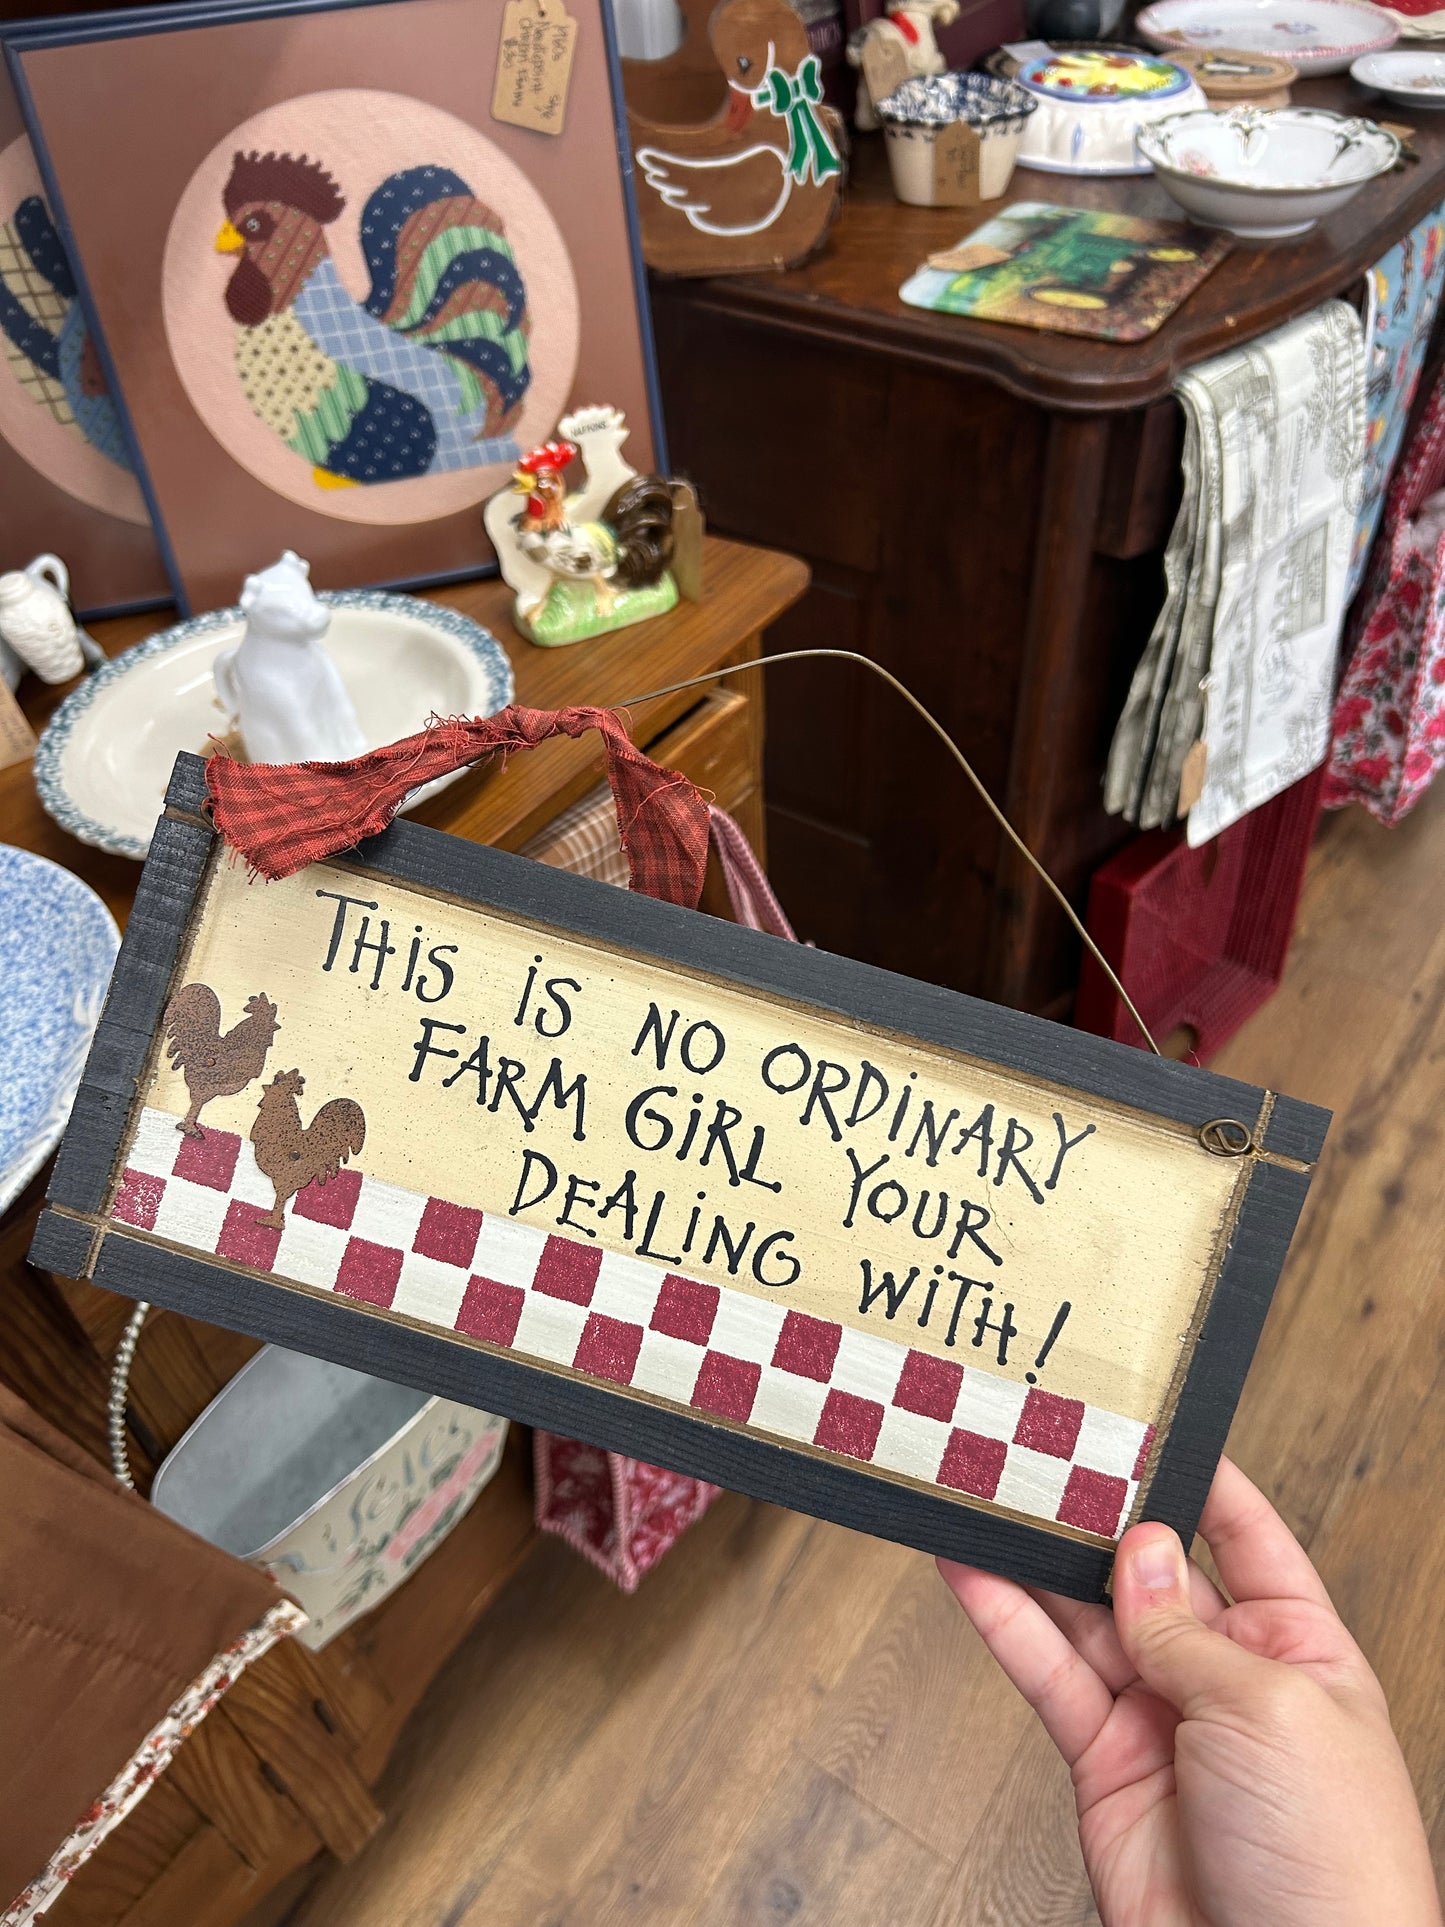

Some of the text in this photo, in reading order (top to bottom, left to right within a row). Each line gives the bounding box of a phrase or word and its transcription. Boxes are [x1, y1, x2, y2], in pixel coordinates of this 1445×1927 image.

[631, 1002, 726, 1075] NO
[408, 1018, 587, 1141] FARM
[842, 1147, 1003, 1266] YOUR
